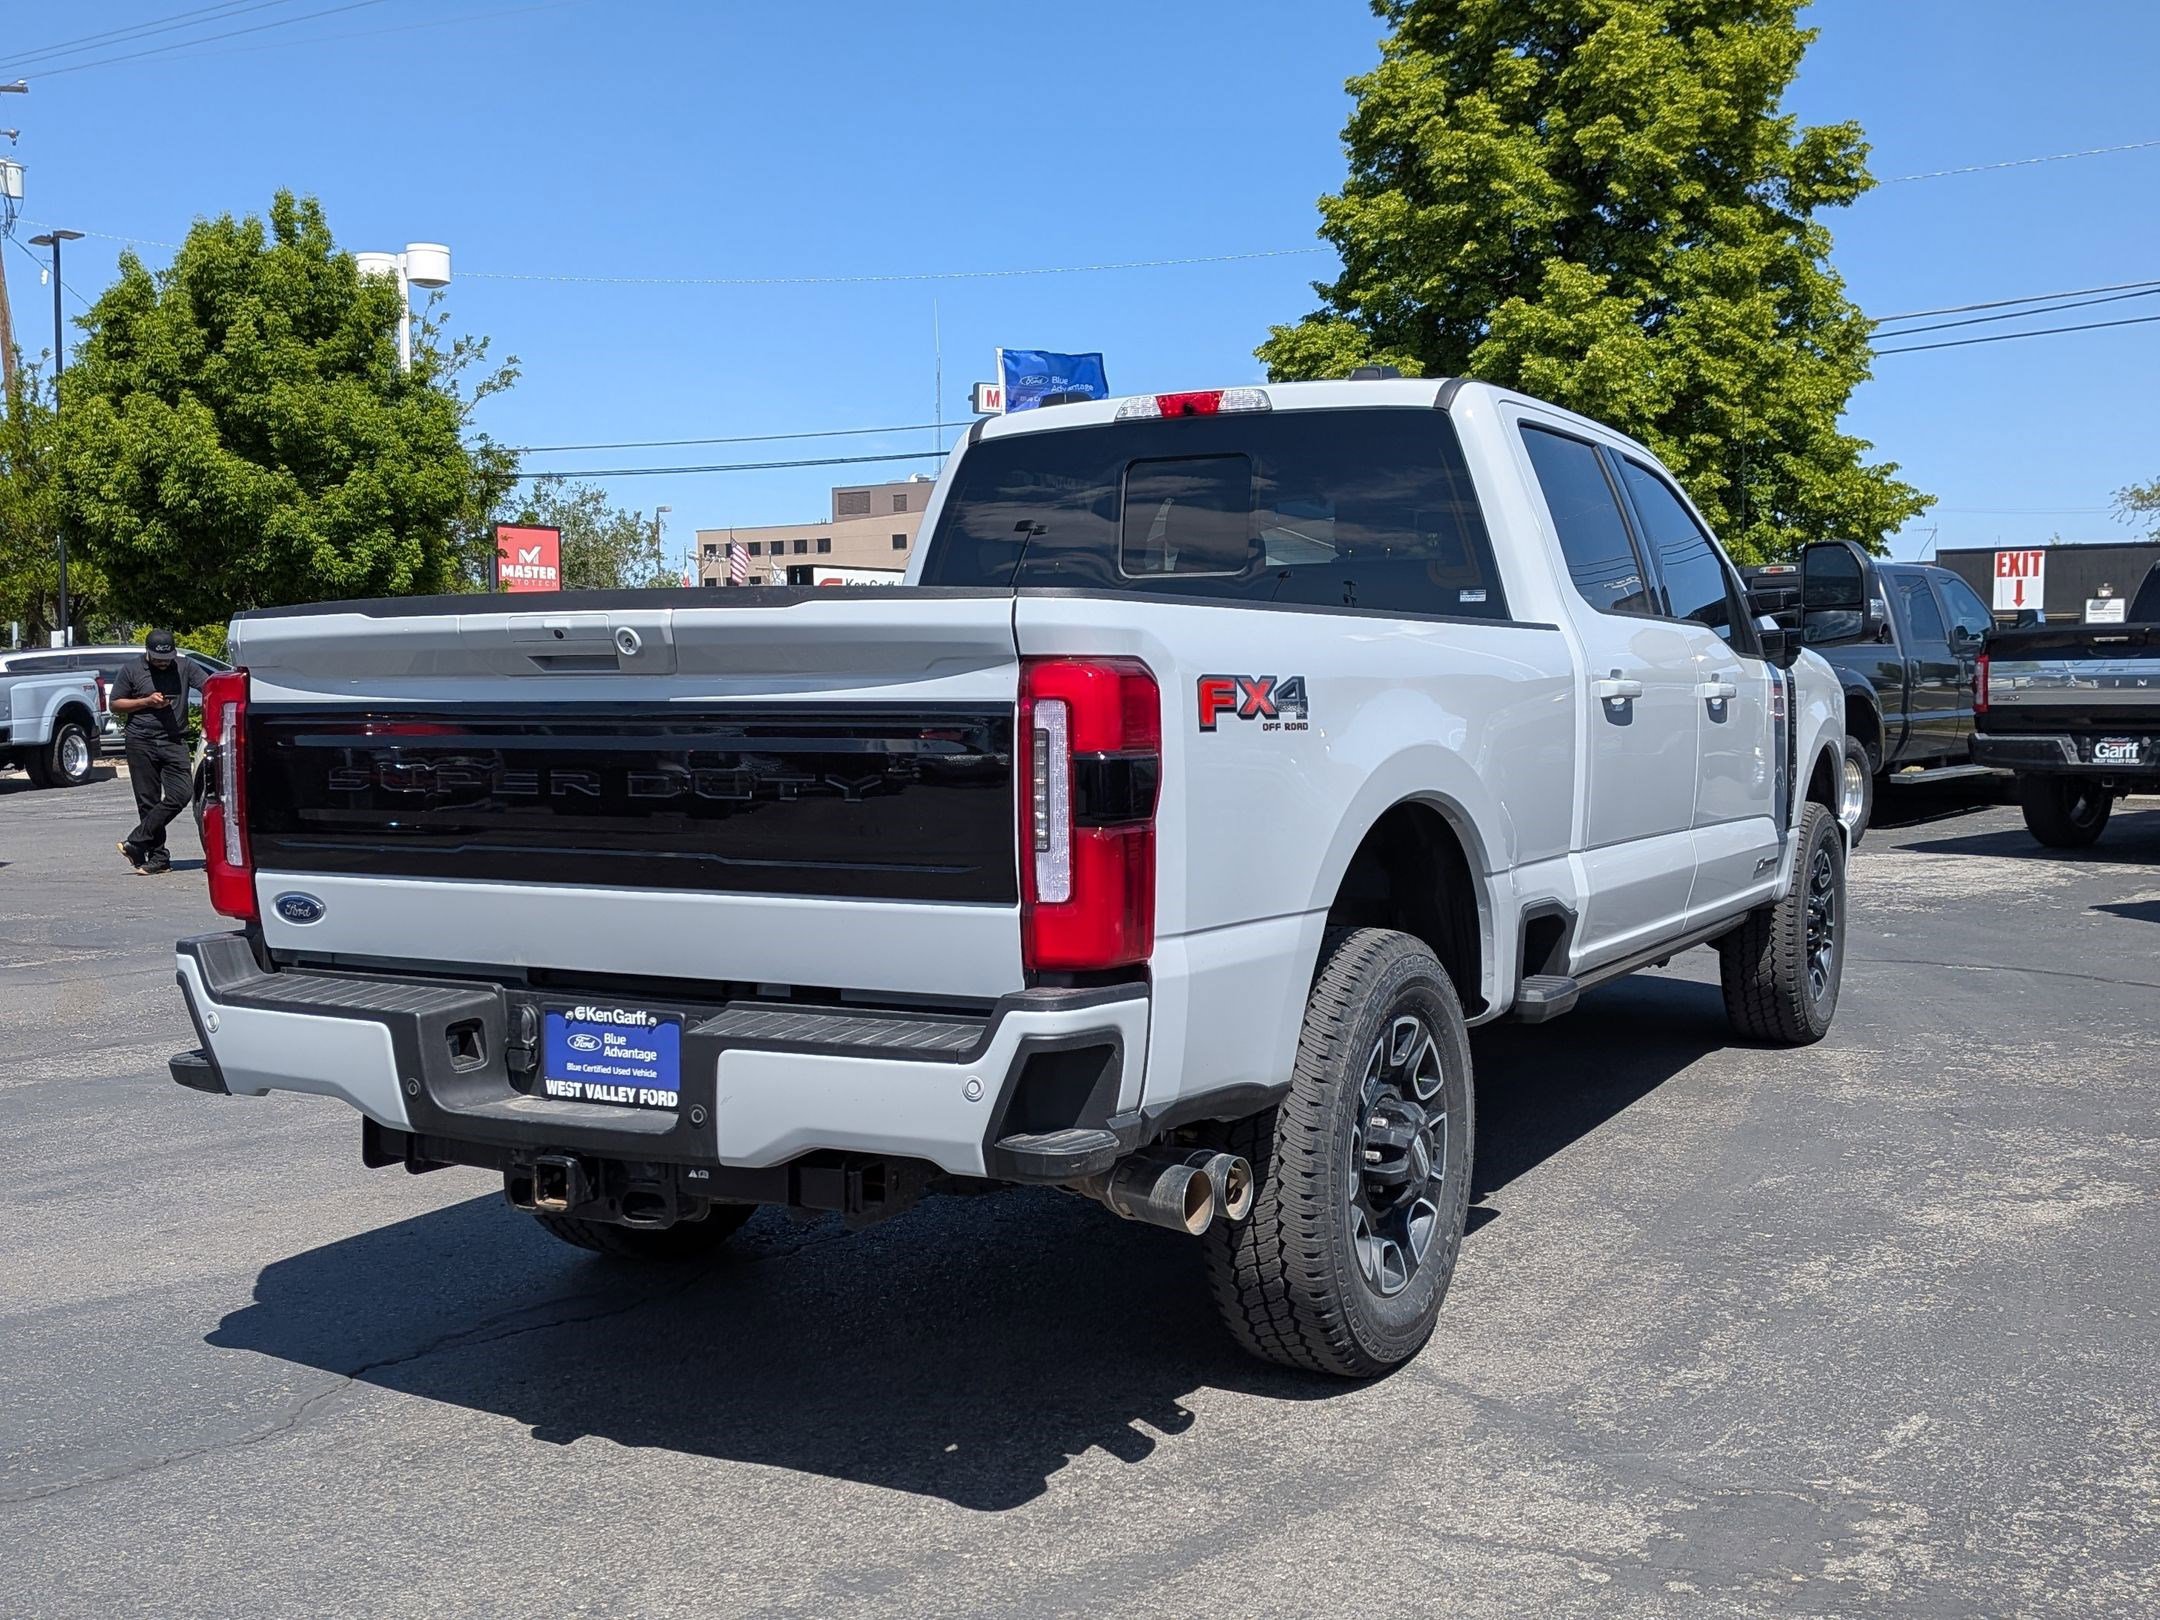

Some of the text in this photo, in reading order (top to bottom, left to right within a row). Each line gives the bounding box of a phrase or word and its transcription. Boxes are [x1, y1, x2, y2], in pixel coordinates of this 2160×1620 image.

[1050, 383, 1094, 393] Advantage
[1051, 375, 1069, 385] Blue
[501, 564, 557, 579] MASTER
[1996, 551, 2043, 577] EXIT
[1197, 674, 1308, 733] FX4
[1262, 722, 1308, 731] OFF ROAD
[2095, 742, 2140, 758] Garff
[328, 761, 883, 802] SUPER DUTY
[586, 1006, 647, 1026] Ken Garff
[573, 1035, 596, 1049] Ford
[603, 1033, 627, 1045] Blue
[603, 1046, 658, 1062] Advantage
[566, 1062, 658, 1078] Blue Certified Used Vehicle
[545, 1079, 679, 1107] WEST VALLEY FORD
